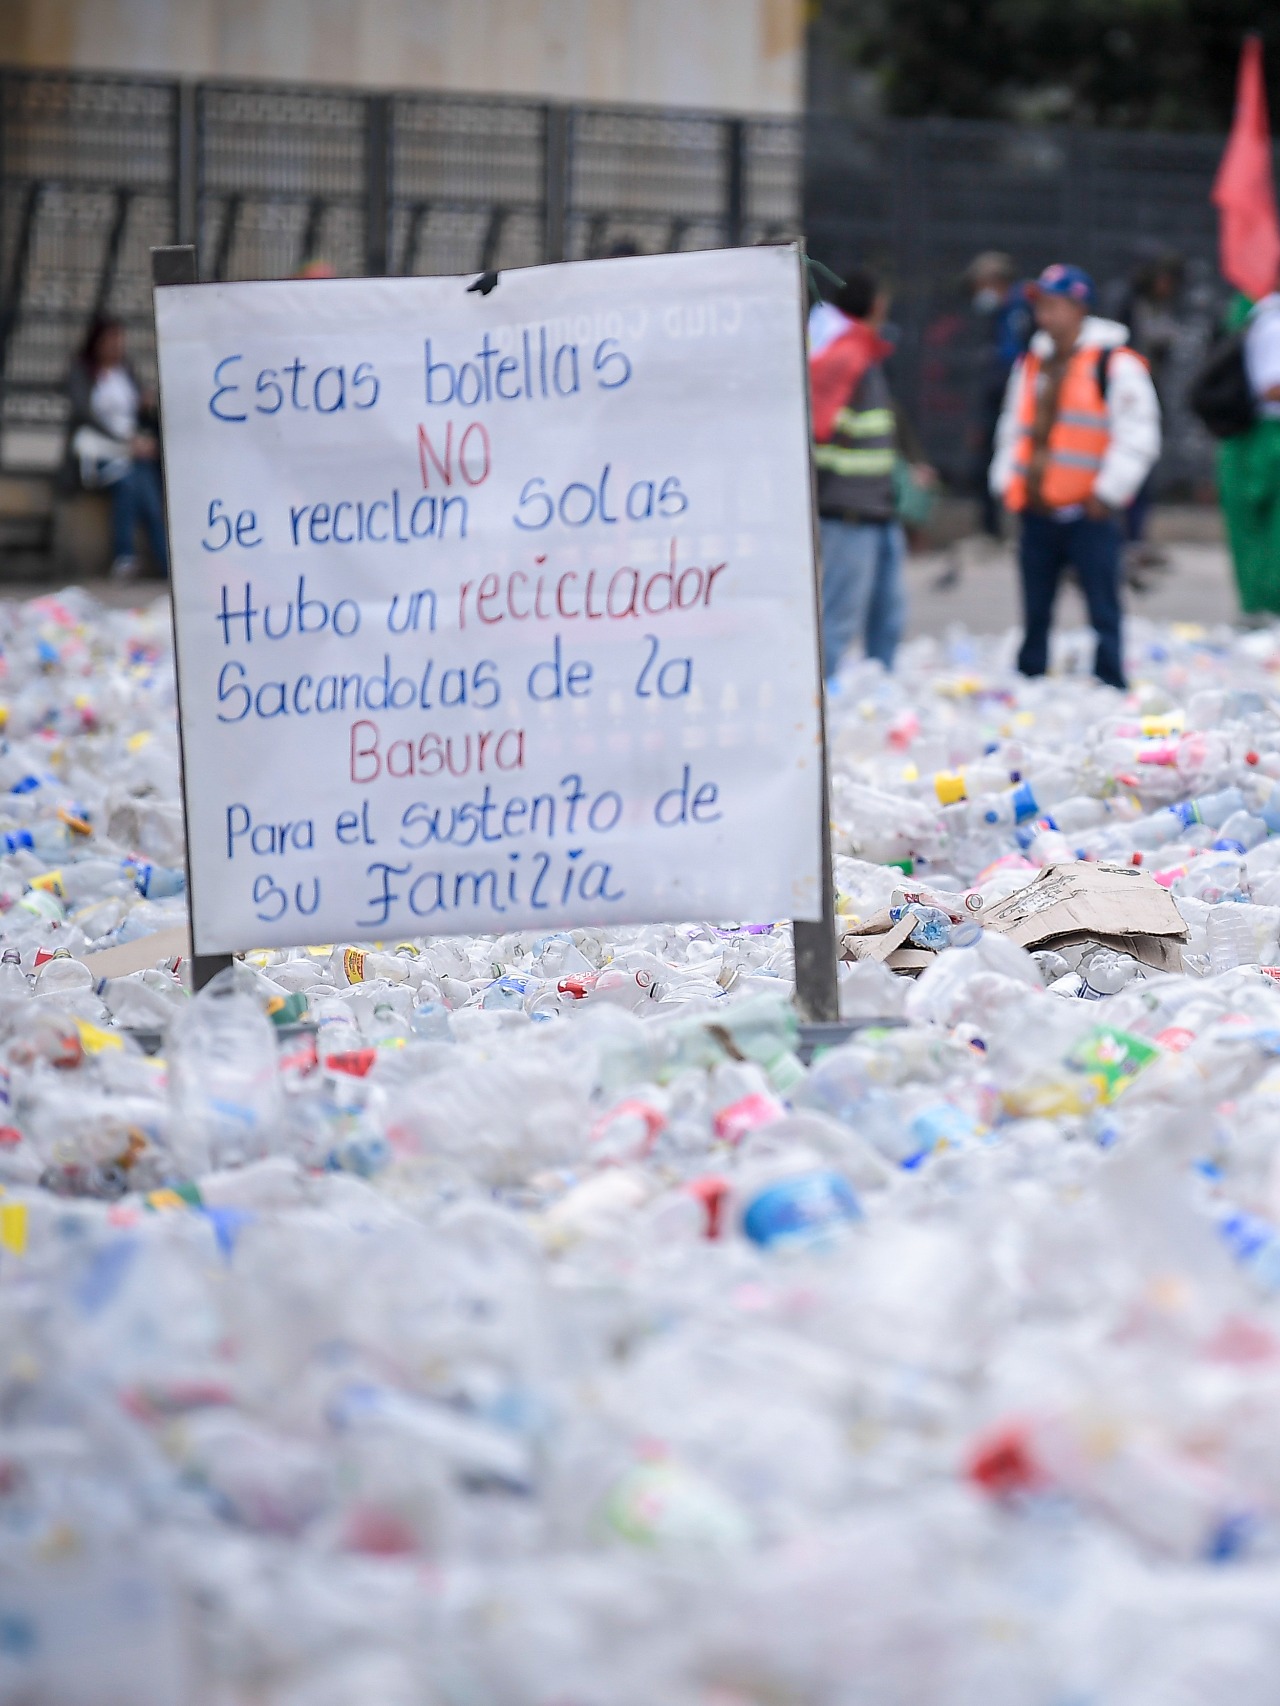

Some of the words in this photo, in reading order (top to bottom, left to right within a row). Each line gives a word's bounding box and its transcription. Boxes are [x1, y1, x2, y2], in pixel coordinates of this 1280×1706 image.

[207, 353, 382, 425] Estas
[423, 326, 633, 407] botellas
[417, 420, 492, 490] NO
[289, 488, 469, 548] reciclan
[215, 573, 362, 647] Hubo
[386, 588, 438, 635] un
[458, 540, 728, 631] reciclador
[216, 652, 502, 728] Sacandolas
[526, 633, 594, 702] de
[634, 634, 694, 700] la
[349, 718, 526, 785] Basura
[225, 802, 316, 861] Para
[334, 799, 378, 847] el
[653, 762, 722, 825] de
[356, 847, 625, 929] Familia
